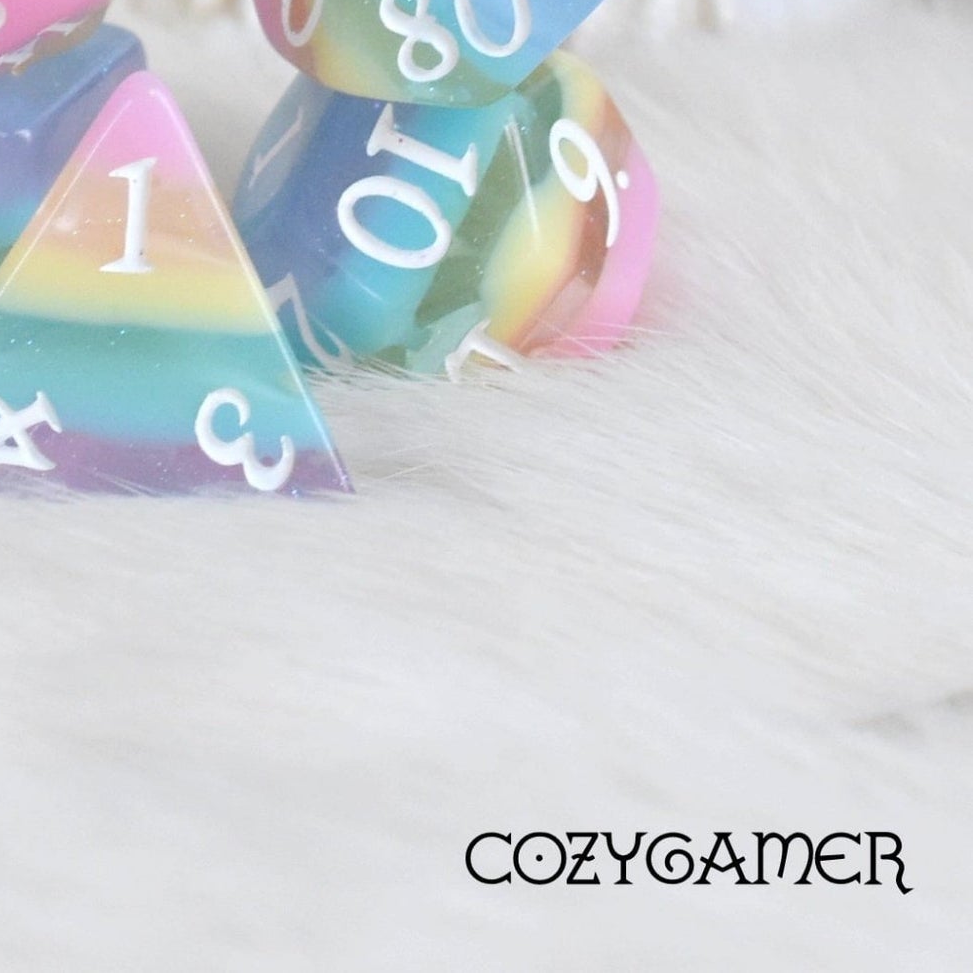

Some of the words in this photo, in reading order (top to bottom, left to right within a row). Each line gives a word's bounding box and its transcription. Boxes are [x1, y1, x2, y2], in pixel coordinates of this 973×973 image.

[99, 156, 160, 275] 1
[336, 102, 478, 270] 10
[194, 387, 295, 492] 3
